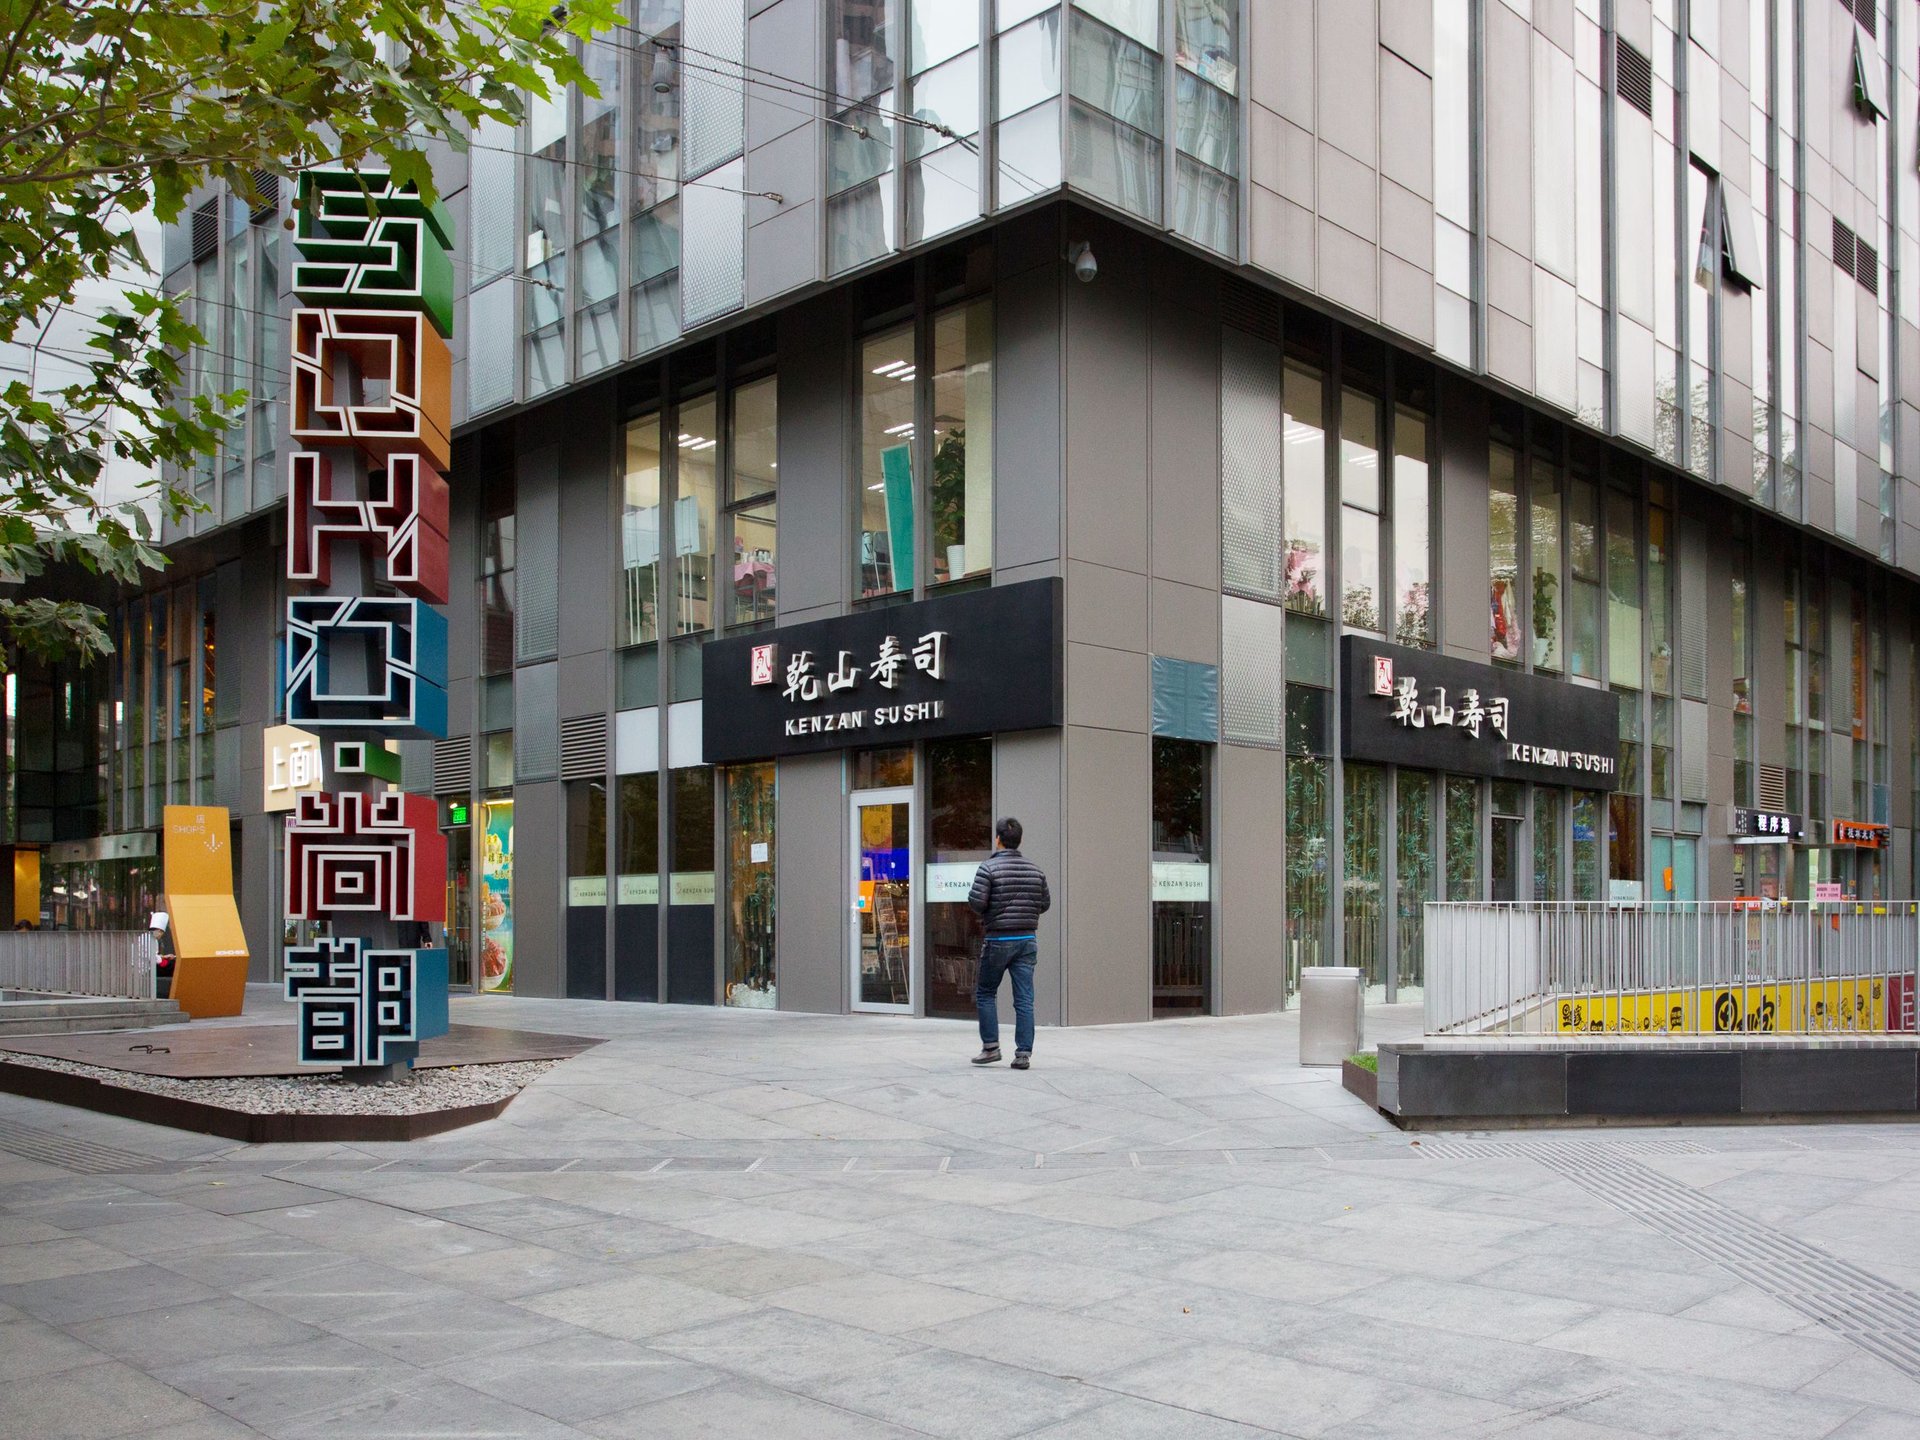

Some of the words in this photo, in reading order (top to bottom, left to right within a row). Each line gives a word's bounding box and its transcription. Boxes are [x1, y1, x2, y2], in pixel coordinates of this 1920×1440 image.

[782, 631, 949, 703] 乾山寿司
[785, 709, 865, 737] KENZAN
[873, 700, 944, 727] SUSHI
[1392, 676, 1510, 740] 乾山寿司
[1511, 742, 1571, 769] KENZAN
[1574, 752, 1615, 775] SUSHI
[172, 825, 206, 835] SHOPS
[1185, 880, 1203, 888] SUSHI
[283, 790, 419, 1067] 尚都
